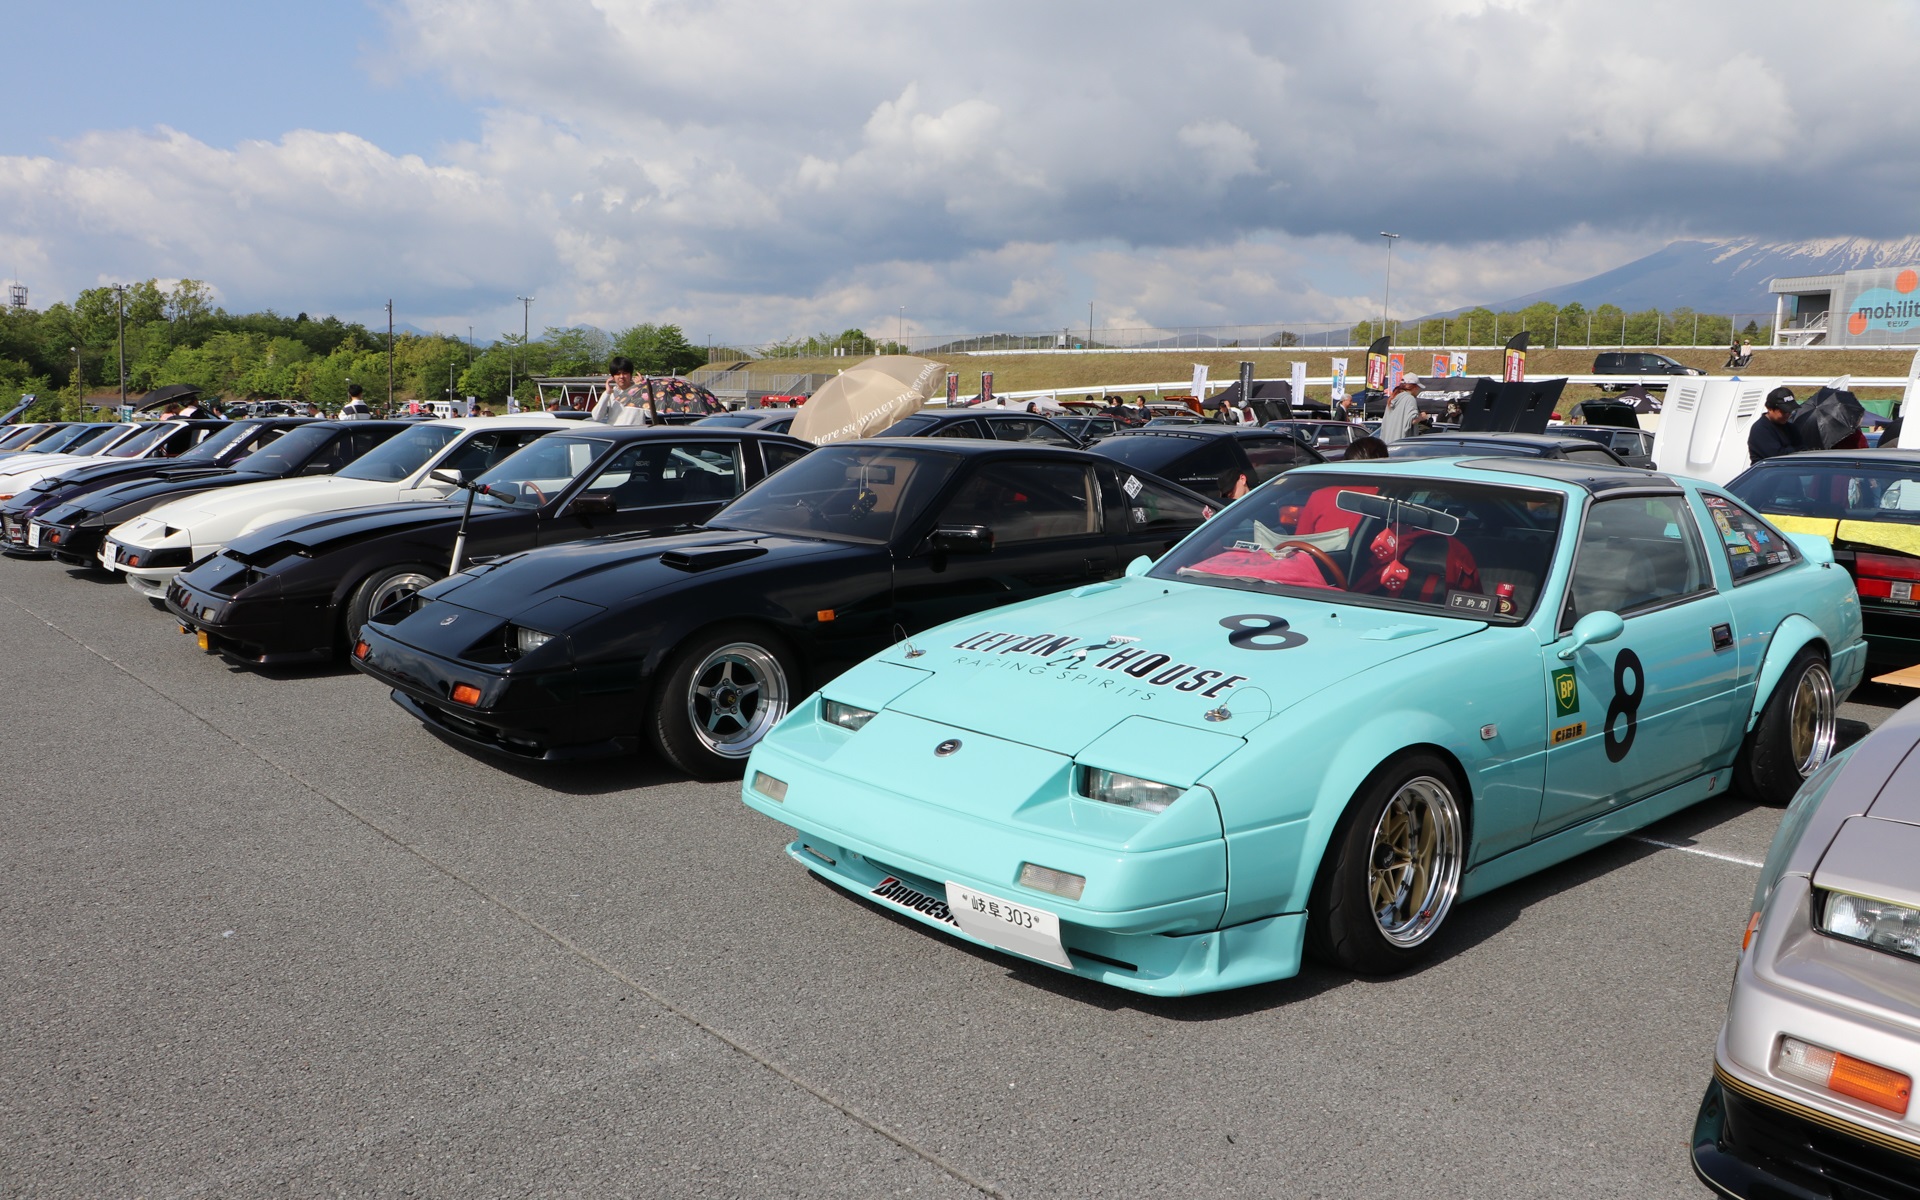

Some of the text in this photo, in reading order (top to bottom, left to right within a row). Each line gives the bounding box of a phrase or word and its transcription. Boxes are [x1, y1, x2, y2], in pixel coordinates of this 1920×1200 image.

[842, 399, 894, 432] summer
[1454, 596, 1489, 610] 予約席
[1219, 614, 1309, 650] 8
[1056, 671, 1157, 701] SPIRITS
[1094, 647, 1250, 699] HOUSE
[1560, 680, 1574, 699] BP
[1604, 648, 1645, 763] 8
[1004, 905, 1033, 929] 303
